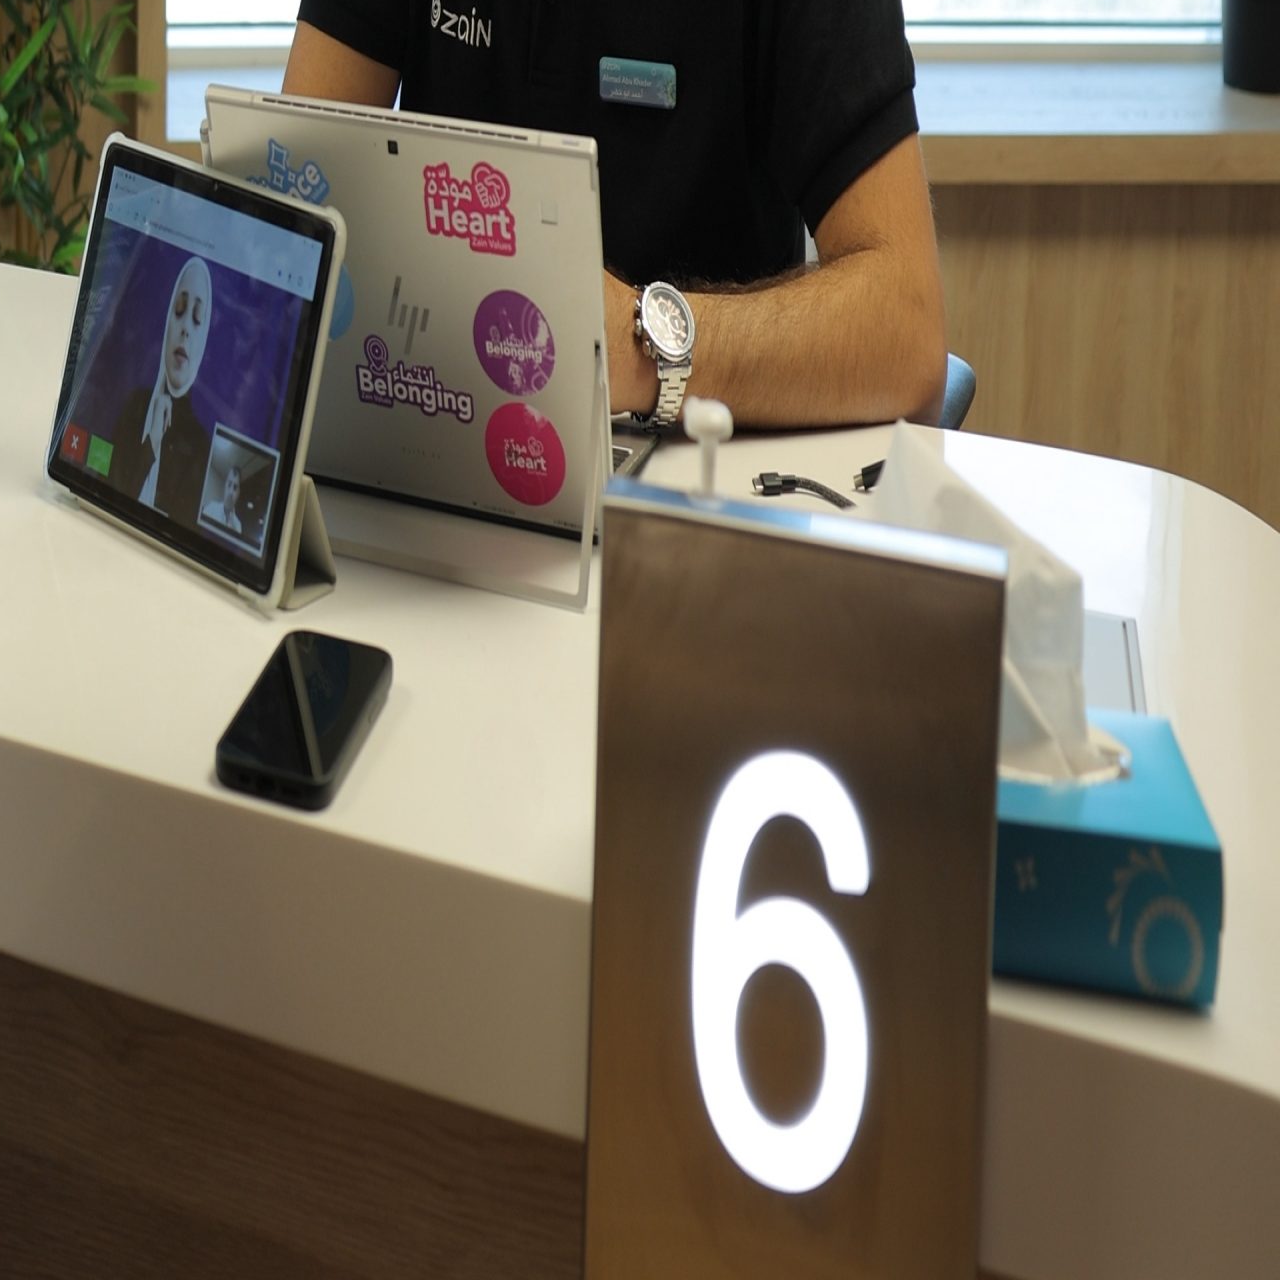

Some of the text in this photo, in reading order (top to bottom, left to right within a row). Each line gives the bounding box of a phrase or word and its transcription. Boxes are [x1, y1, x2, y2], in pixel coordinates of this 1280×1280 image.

[427, 197, 512, 240] Heart
[485, 339, 543, 364] Belonging
[358, 366, 472, 421] Belonging
[504, 451, 547, 472] Heart
[692, 752, 868, 1191] 6
